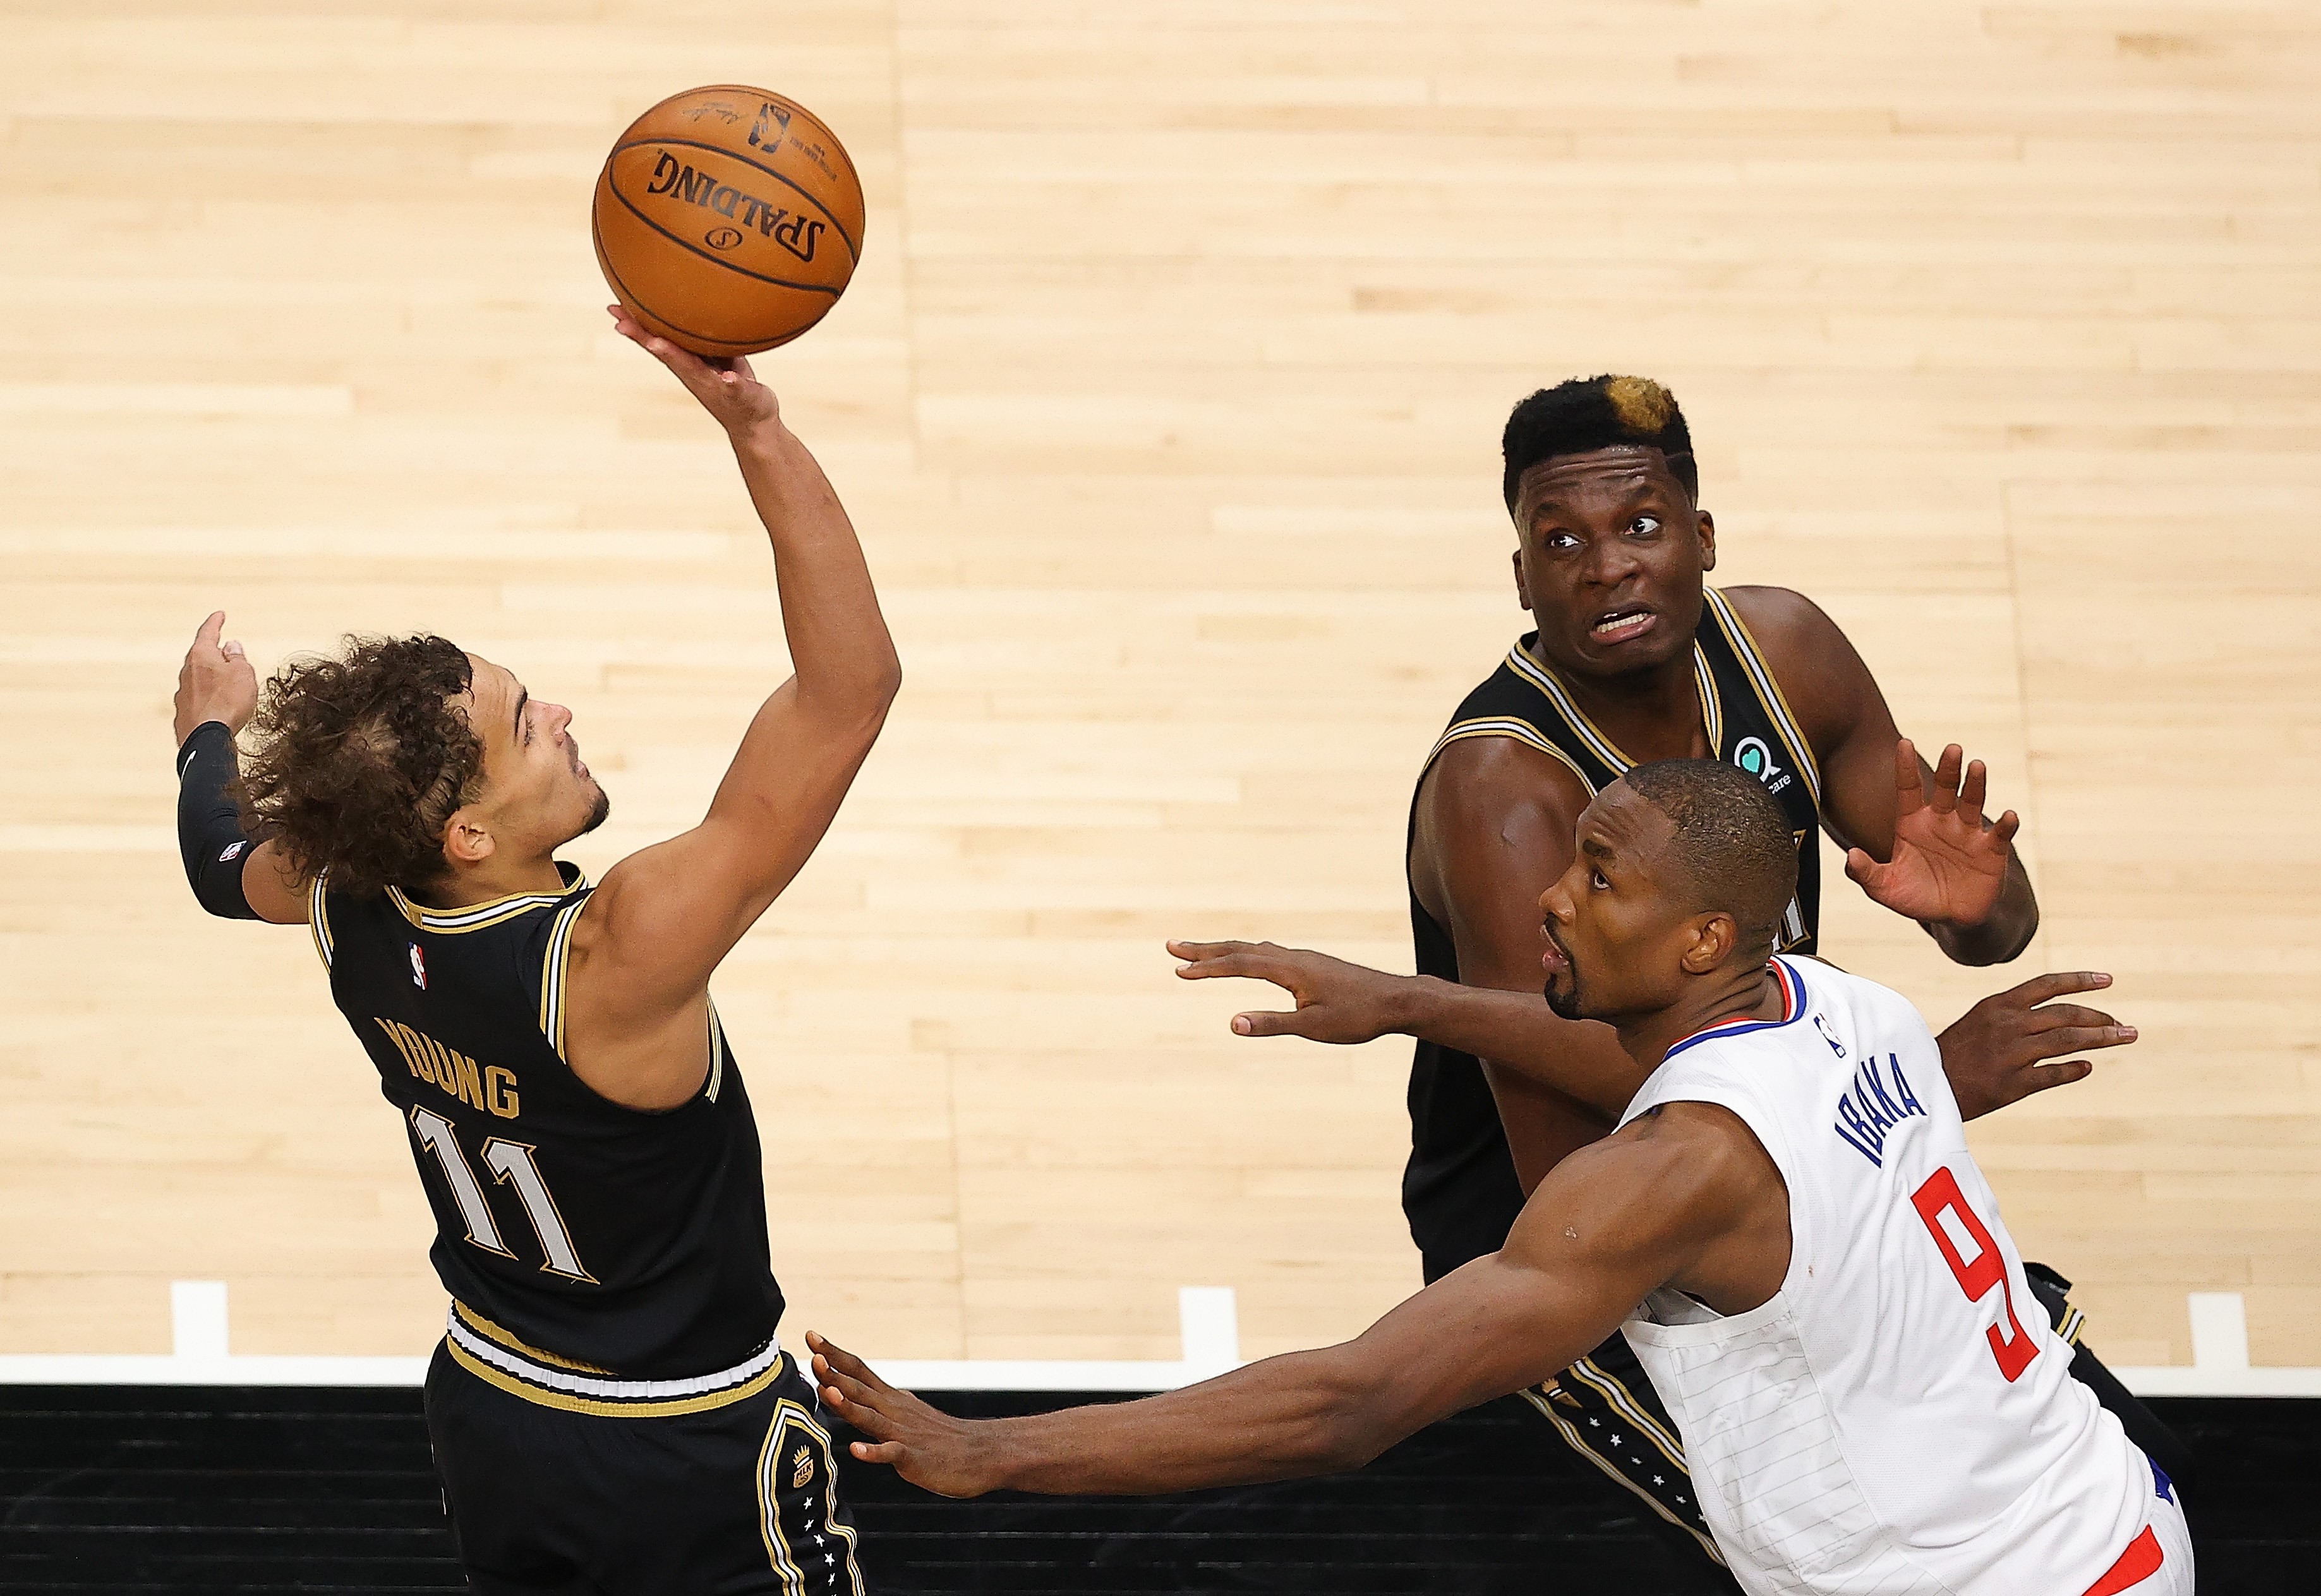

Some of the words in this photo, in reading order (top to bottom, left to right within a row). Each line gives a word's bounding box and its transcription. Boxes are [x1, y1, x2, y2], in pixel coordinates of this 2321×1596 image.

[648, 152, 825, 261] SPALDING
[374, 1017, 520, 1119] YOUNG
[1835, 1053, 1927, 1168] IBAKA
[409, 1104, 600, 1285] 11
[1910, 1166, 2041, 1383] 9
[797, 1463, 812, 1479] MLK
